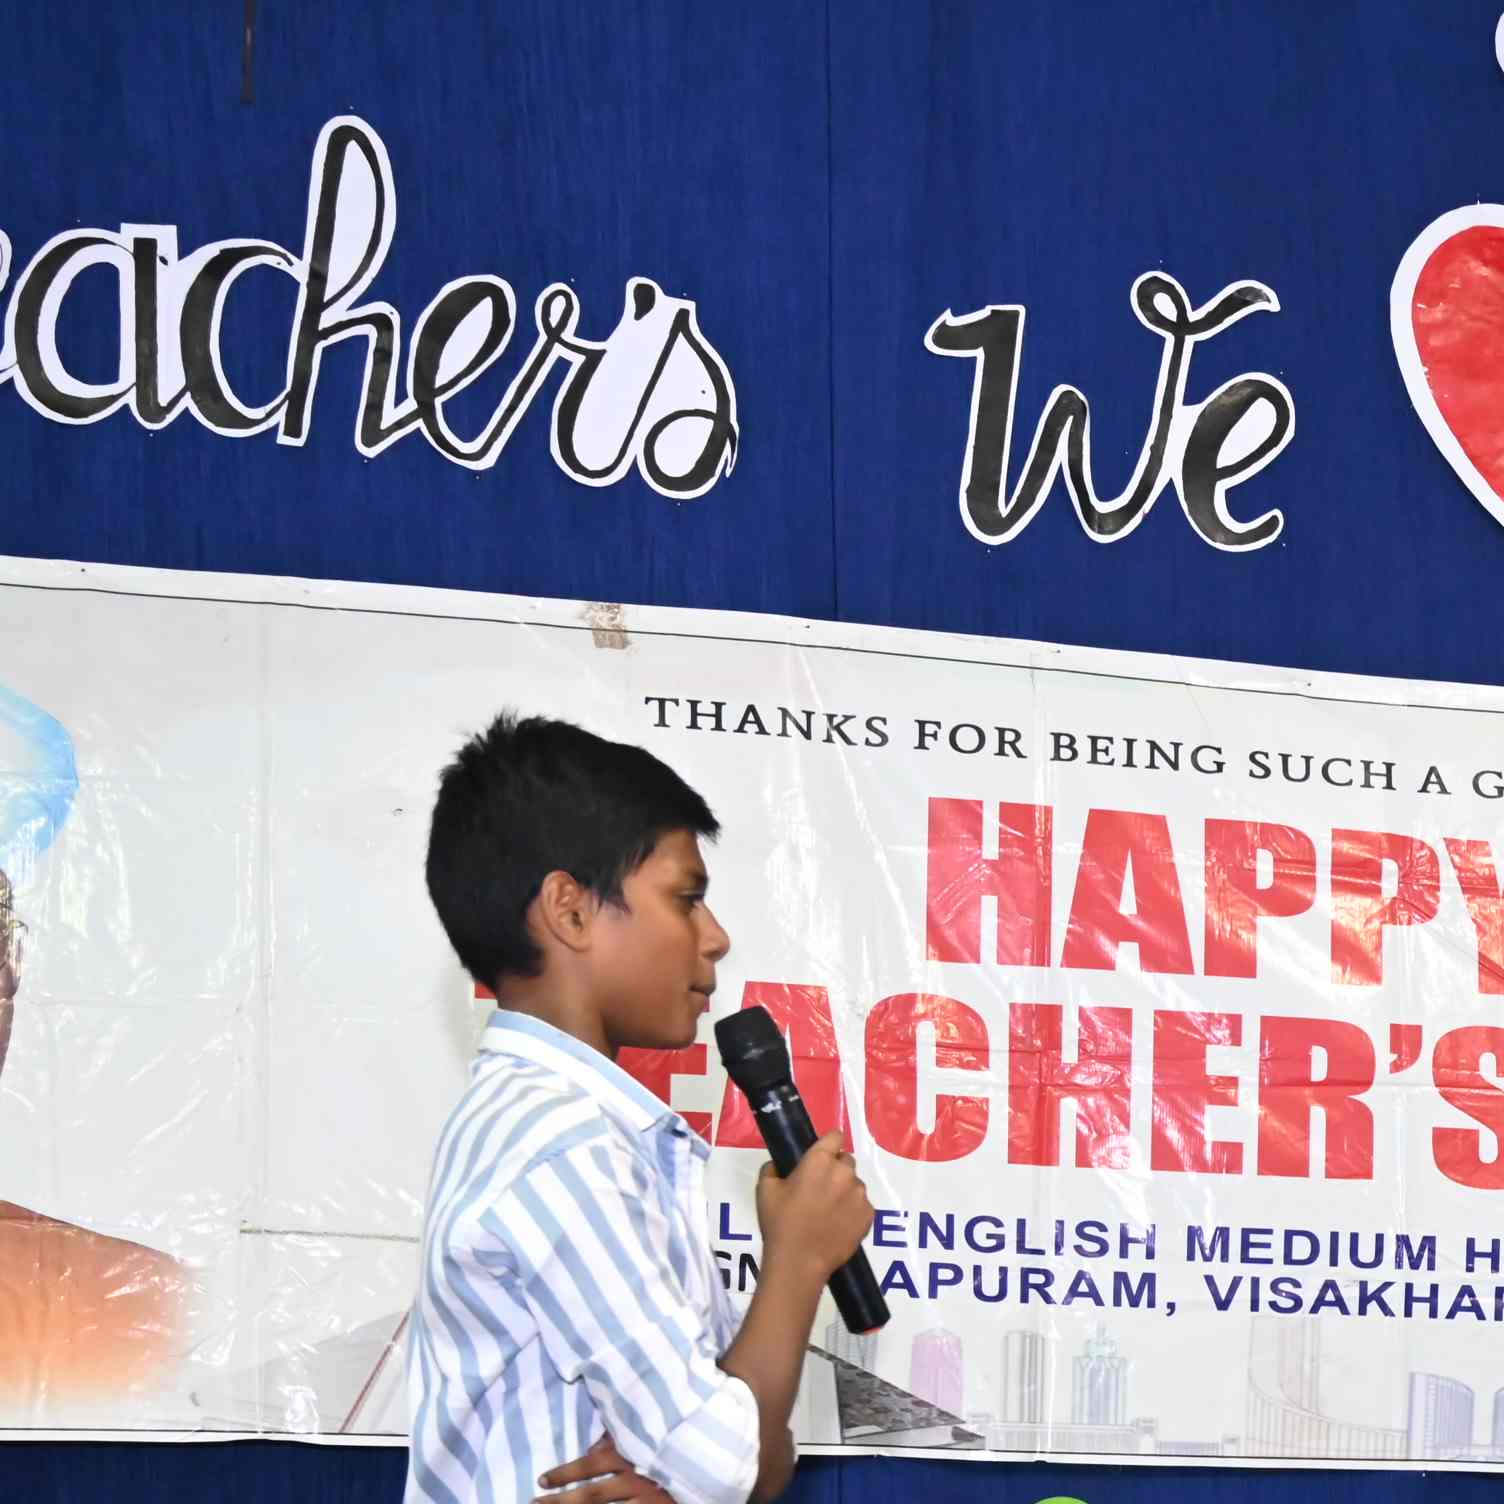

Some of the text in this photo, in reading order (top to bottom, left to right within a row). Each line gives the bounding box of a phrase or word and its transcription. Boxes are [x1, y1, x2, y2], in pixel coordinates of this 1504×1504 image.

[0, 118, 740, 497] acher's
[928, 272, 1293, 549] We
[645, 696, 889, 748] THANKS
[913, 719, 1028, 759] FOR
[1049, 732, 1226, 775] BEING
[1248, 750, 1397, 791] SUCH
[1417, 765, 1452, 796] A
[872, 1208, 1157, 1261] ENGLISH
[1186, 1224, 1437, 1272] MEDIUM
